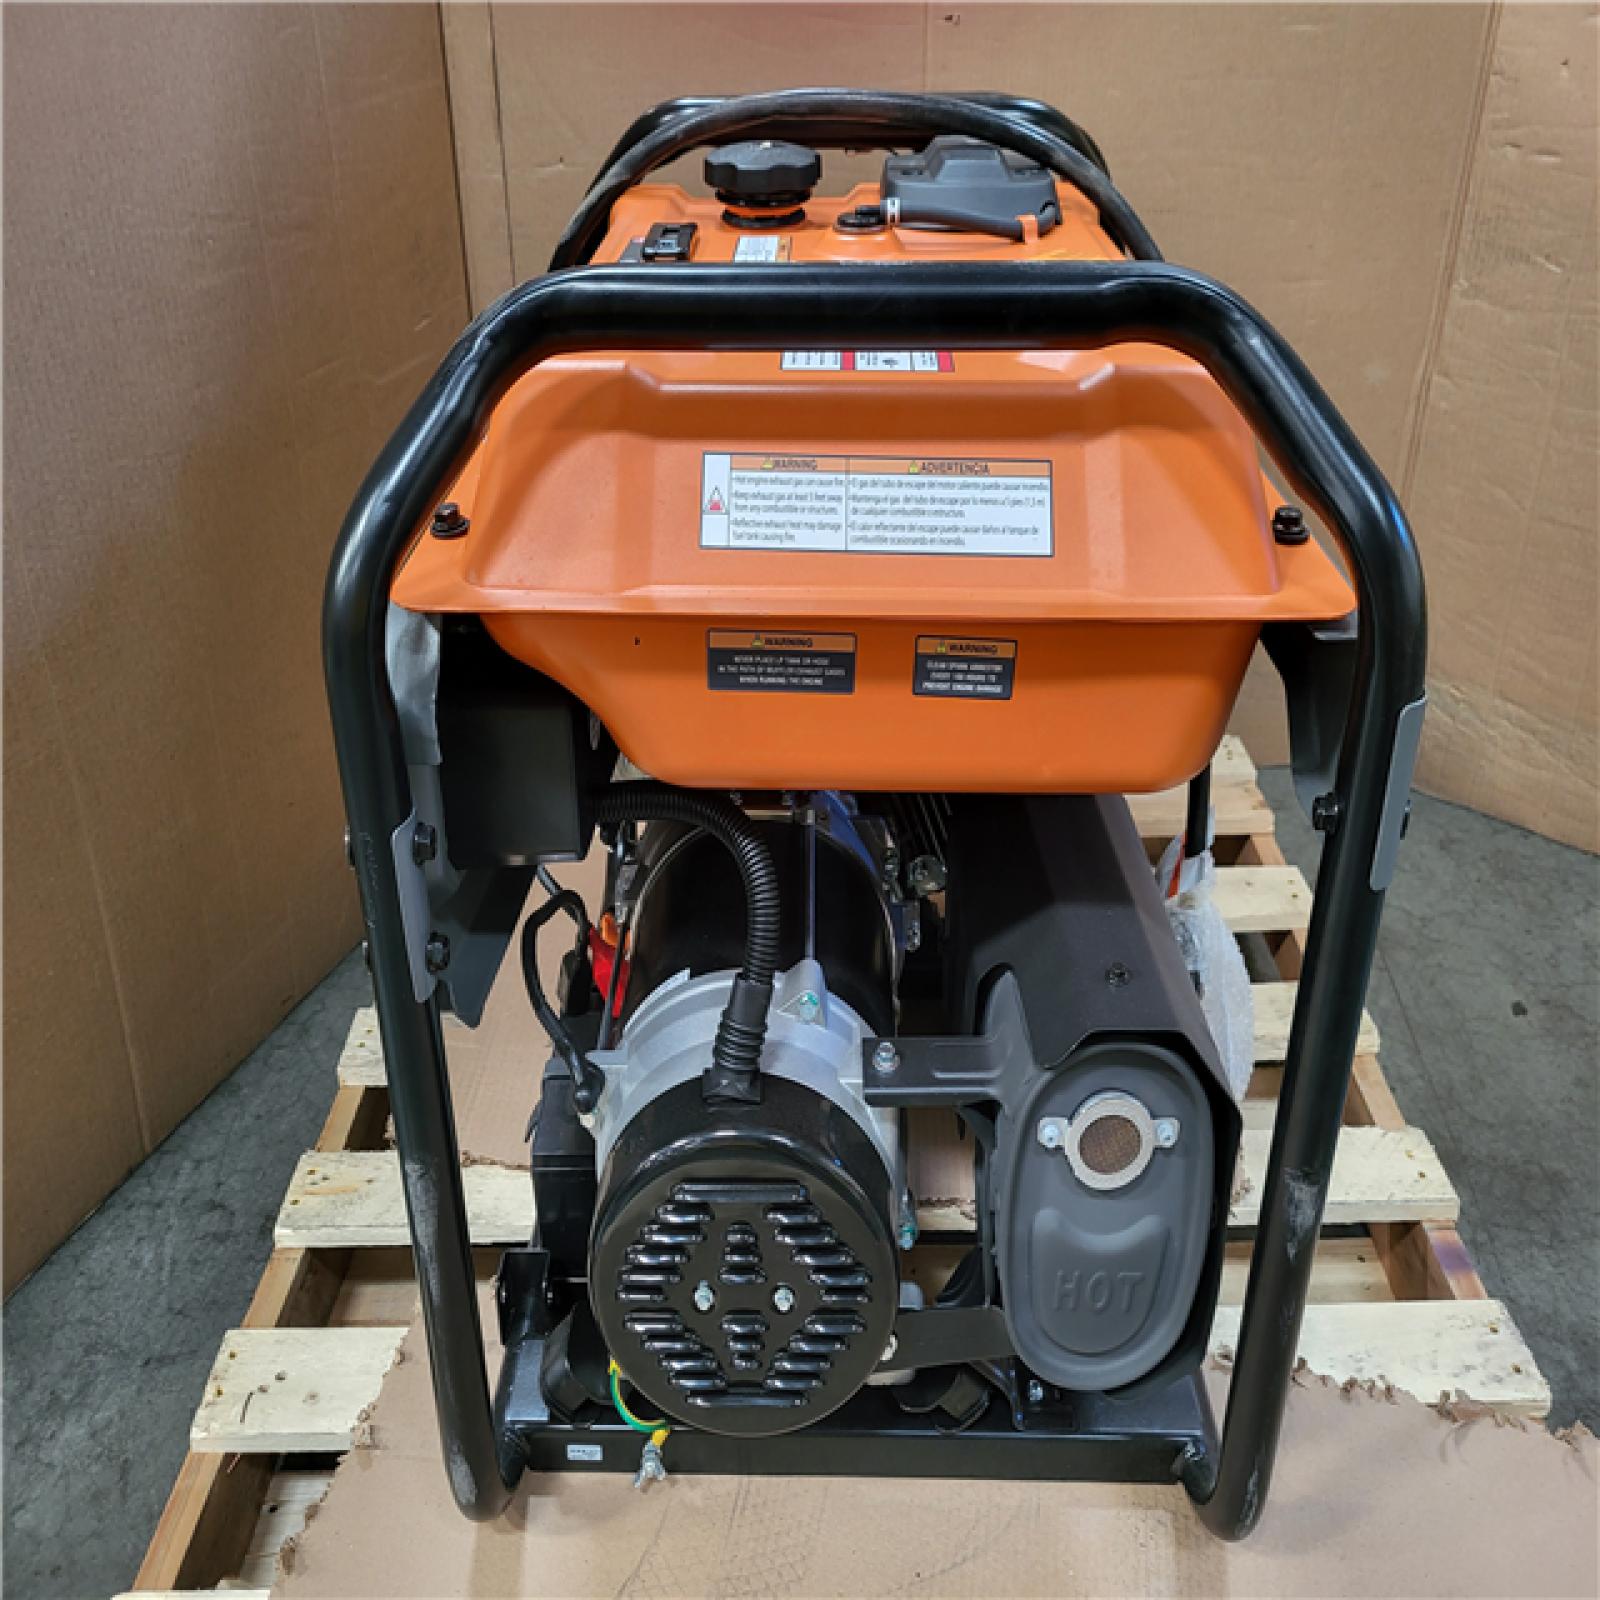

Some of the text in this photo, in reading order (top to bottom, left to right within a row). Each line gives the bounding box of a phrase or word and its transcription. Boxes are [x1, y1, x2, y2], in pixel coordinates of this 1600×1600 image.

[773, 458, 818, 470] WARNING
[920, 461, 990, 474] ADVERTENCIA
[769, 477, 793, 486] exhaust
[765, 637, 813, 647] WARNING
[949, 645, 998, 654] WARNING
[1053, 1269, 1146, 1314] HOT
